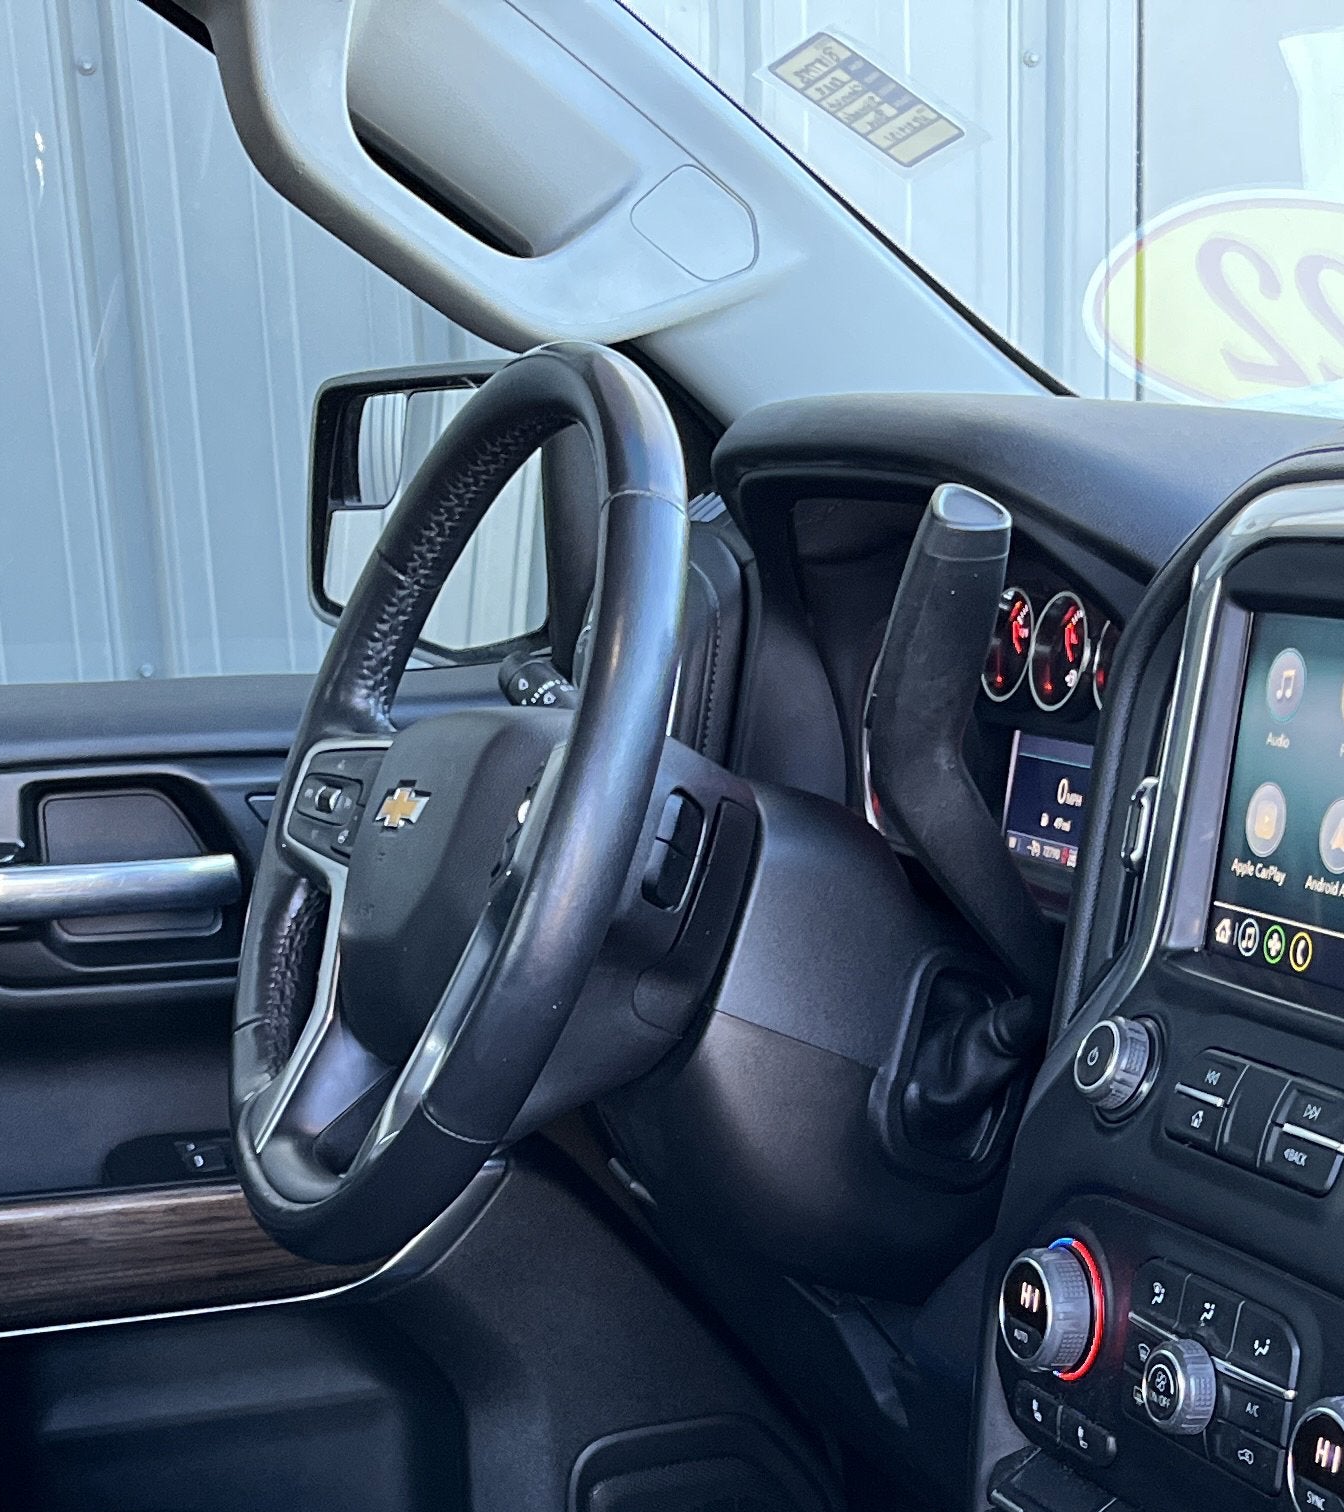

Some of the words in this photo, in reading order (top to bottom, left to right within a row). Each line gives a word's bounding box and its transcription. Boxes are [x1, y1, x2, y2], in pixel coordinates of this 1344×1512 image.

[1266, 732, 1290, 748] Audio
[1231, 858, 1254, 878] Apple
[1255, 864, 1286, 886] CarPlay
[1305, 875, 1339, 896] Android
[1020, 1282, 1040, 1313] HI
[1315, 1437, 1341, 1473] HI
